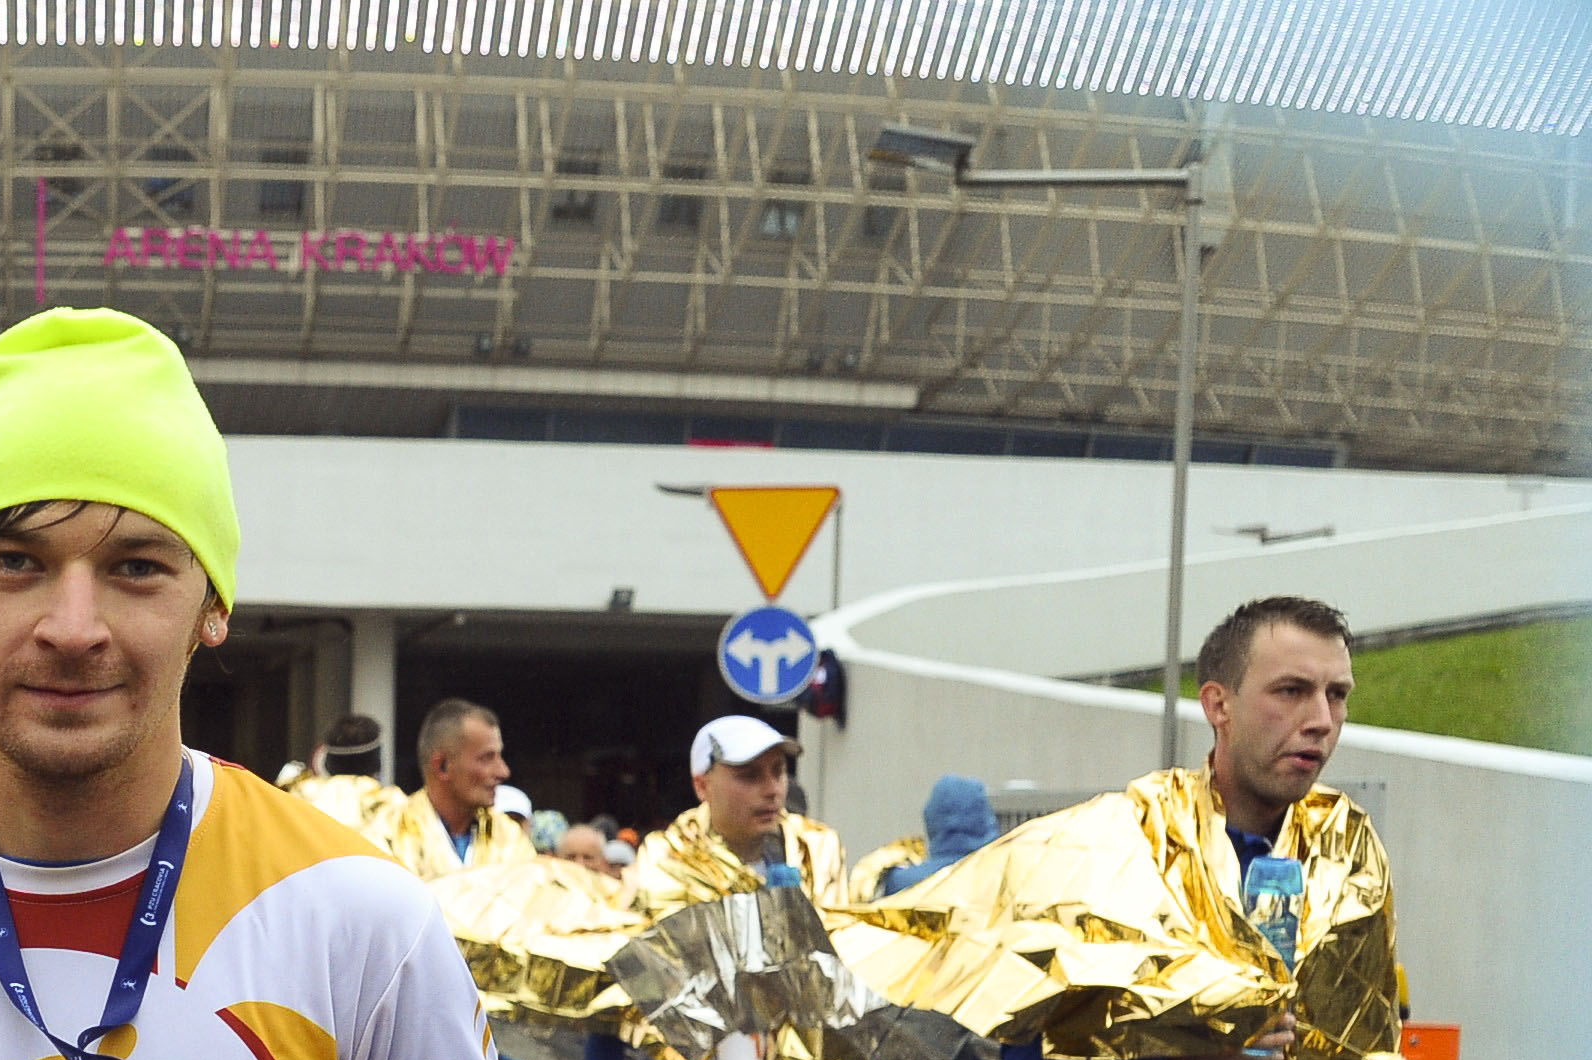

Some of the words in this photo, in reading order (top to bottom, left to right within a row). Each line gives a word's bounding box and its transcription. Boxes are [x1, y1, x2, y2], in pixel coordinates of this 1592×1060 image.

[105, 226, 275, 271] ARENA
[296, 219, 514, 276] KRAKÓW
[151, 867, 167, 897] CRACOVIA
